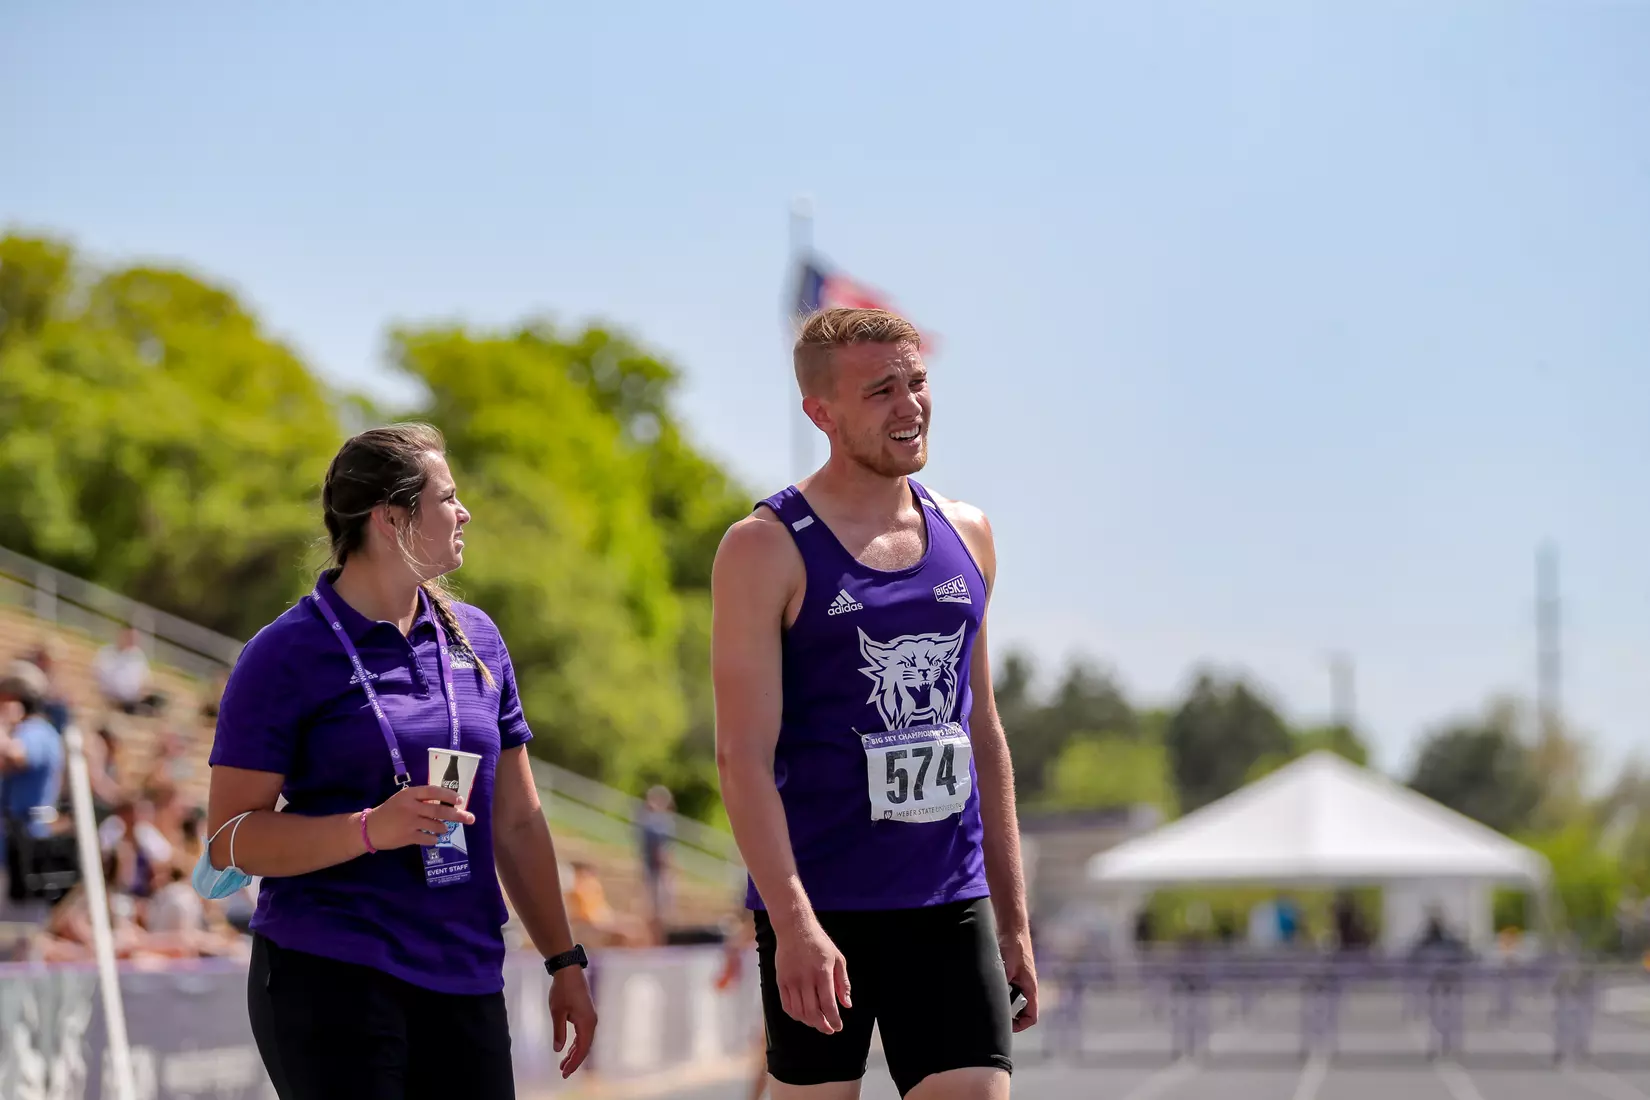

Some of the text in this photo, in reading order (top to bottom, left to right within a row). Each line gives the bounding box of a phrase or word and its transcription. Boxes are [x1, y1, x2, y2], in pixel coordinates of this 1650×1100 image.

[827, 601, 864, 616] adidas
[349, 673, 378, 685] adas
[364, 682, 375, 698] State
[447, 682, 455, 701] Weber
[371, 698, 384, 719] Weber
[871, 736, 884, 745] BIG
[884, 735, 897, 743] SKY
[898, 728, 945, 741] CHAMPIONPS
[885, 744, 957, 804] 574
[896, 808, 917, 818] WEBER
[918, 806, 935, 816] STATE
[427, 863, 469, 877] EVENT STAFF
